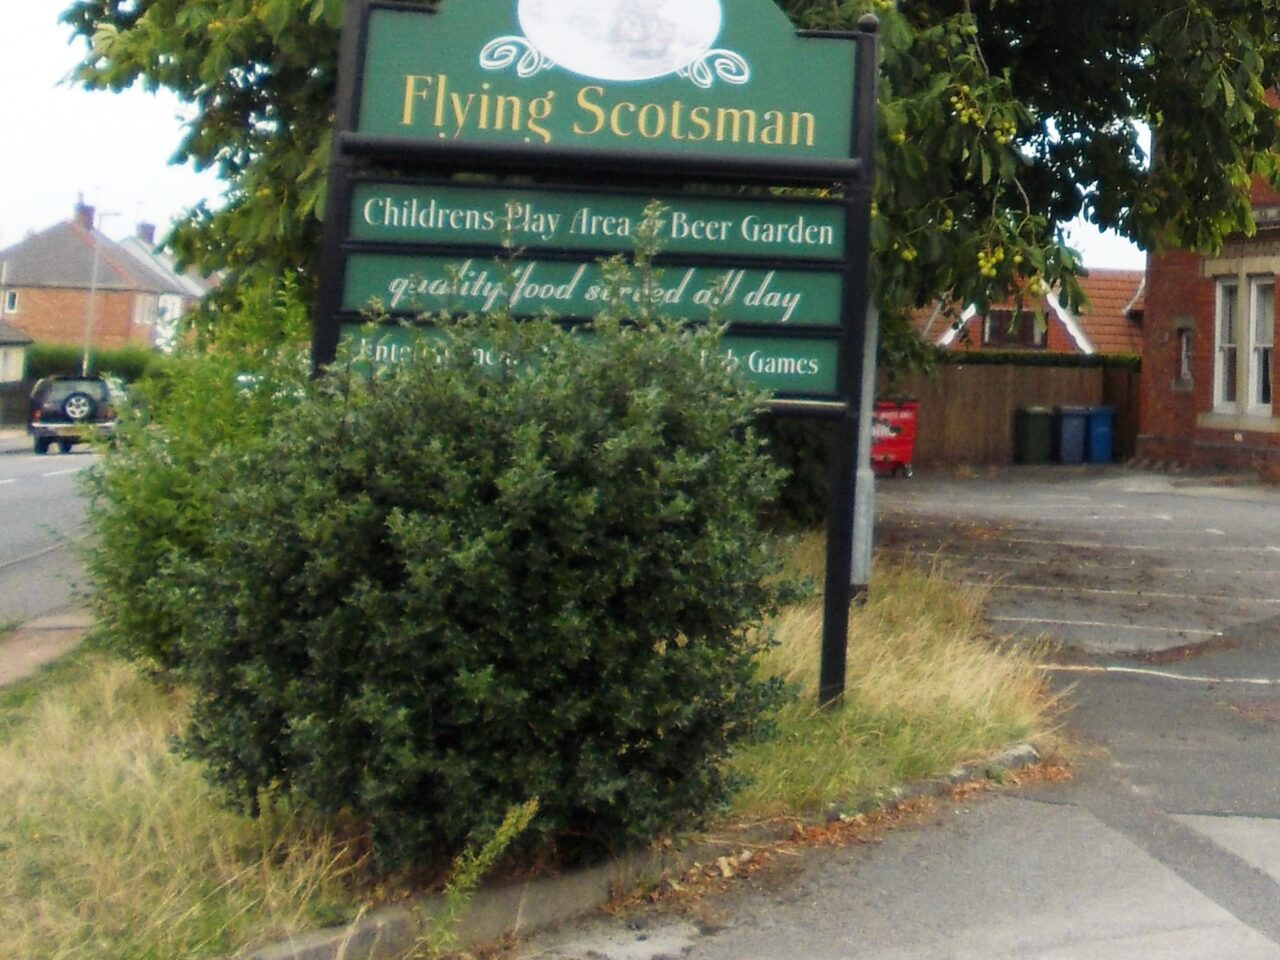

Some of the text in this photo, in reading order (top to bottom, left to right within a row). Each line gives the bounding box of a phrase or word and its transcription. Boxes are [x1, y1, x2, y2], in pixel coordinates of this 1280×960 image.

[401, 74, 816, 146] Flying Scotsman
[364, 197, 495, 230] Childrens
[505, 202, 560, 240] Play
[570, 207, 630, 237] Area
[671, 211, 732, 240] Beer
[742, 215, 833, 245] Garden
[508, 261, 587, 308] food
[744, 270, 801, 322] day
[749, 350, 819, 375] Games
